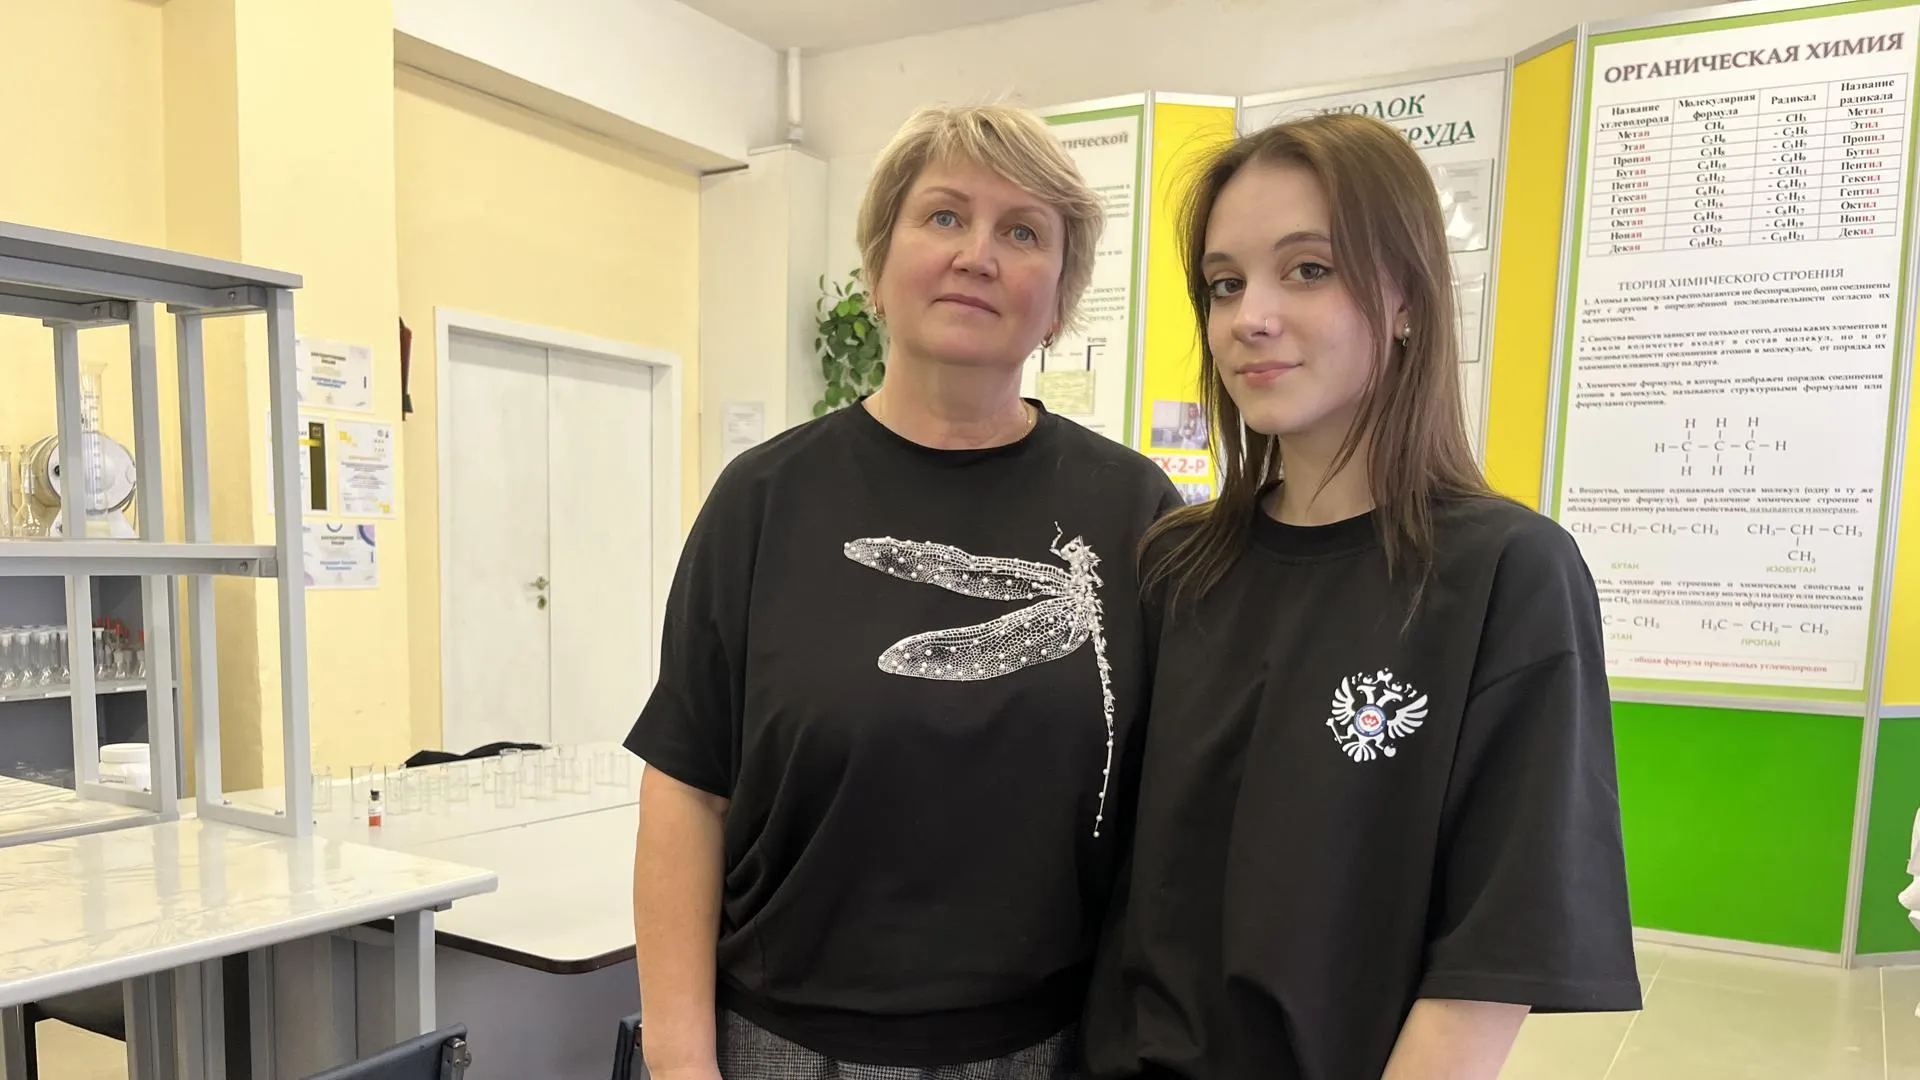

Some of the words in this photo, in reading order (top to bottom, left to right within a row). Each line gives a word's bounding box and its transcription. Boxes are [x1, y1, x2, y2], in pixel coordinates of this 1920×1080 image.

[1603, 44, 1800, 83] ОРГАНИЧЕСКАЯ
[1805, 32, 1904, 60] ХИМИЯ
[1841, 77, 1894, 91] Название
[1678, 92, 1755, 110] Молекулярная
[1771, 92, 1816, 104] Радикал
[1839, 92, 1893, 106] радикала
[1611, 102, 1659, 115] Название
[1692, 106, 1738, 121] формула
[1847, 105, 1884, 117] Метил
[1850, 119, 1878, 130] Этил
[1400, 120, 1475, 147] РУДА
[1618, 128, 1649, 139] Метан
[1842, 132, 1885, 146] Пропил
[1061, 131, 1129, 149] тической
[1620, 141, 1645, 151] Этан
[1845, 145, 1879, 159] Бутил
[1613, 154, 1651, 167] Пропан
[1841, 158, 1882, 170] Пентил
[1616, 167, 1645, 179] Бутан
[1840, 172, 1880, 183] Гексил
[1611, 179, 1648, 190] Пентан
[1840, 185, 1879, 196] Гептил
[1611, 192, 1647, 202] Гексан
[1610, 204, 1646, 215] Гептан
[1840, 199, 1876, 209] Октил
[1611, 218, 1642, 227] Октан
[1840, 212, 1875, 223] Нонил
[1610, 230, 1642, 240] Нонан
[1839, 226, 1873, 237] Декил
[1609, 242, 1640, 253] Декан
[1617, 279, 1665, 290] ТЕОРИЯ
[1670, 272, 1769, 286] ХИМИЧЕСКОГО
[1772, 268, 1843, 281] СТРОЕНИЯ
